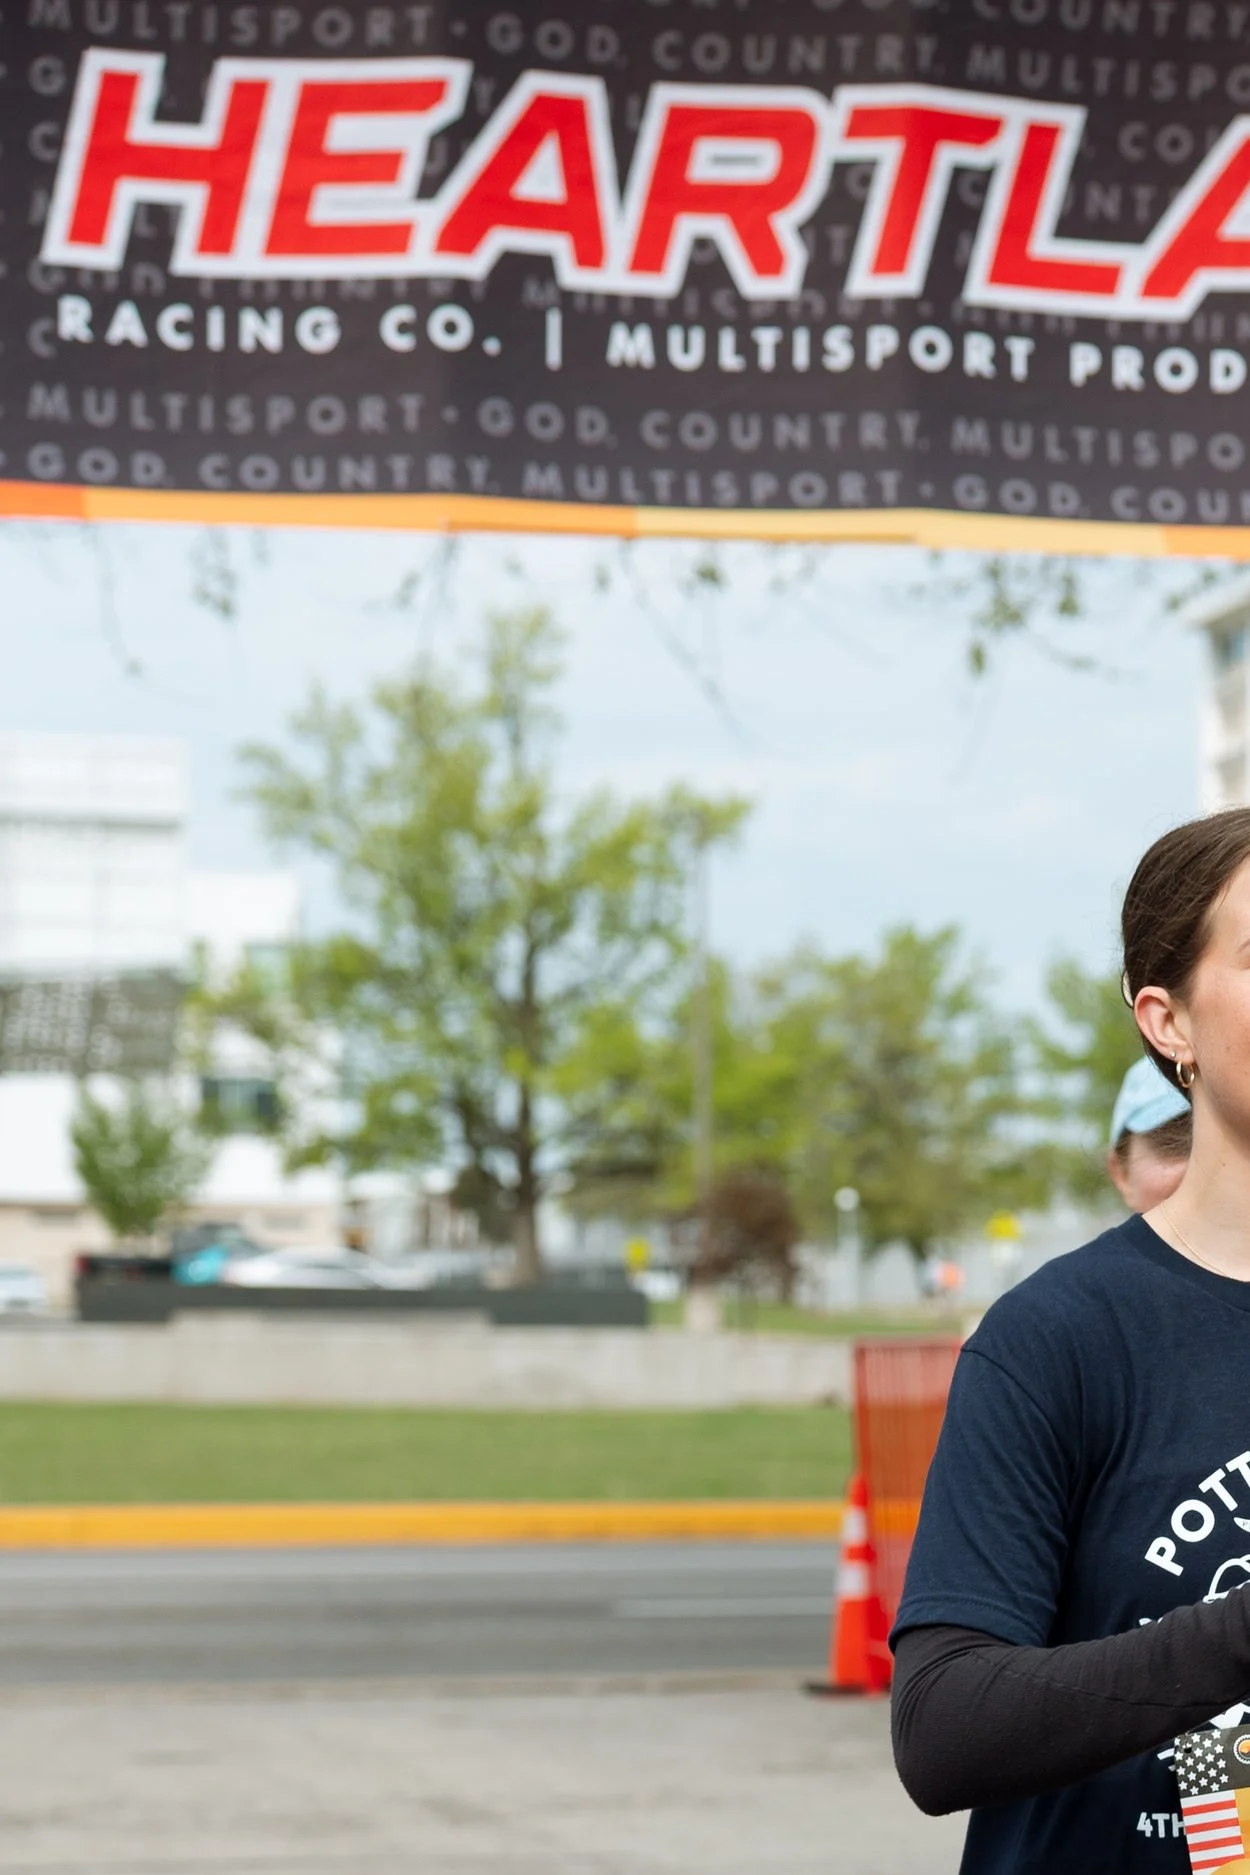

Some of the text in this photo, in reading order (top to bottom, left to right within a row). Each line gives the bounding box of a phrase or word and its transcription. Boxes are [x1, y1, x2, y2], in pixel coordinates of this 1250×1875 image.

[28, 1, 433, 46] MULTISPORT
[57, 295, 342, 354] RACING
[378, 303, 502, 357] CO.
[605, 321, 1036, 381] MULTISPORT
[27, 382, 426, 436] MULTISPORT
[522, 461, 902, 507] MULTISPORT
